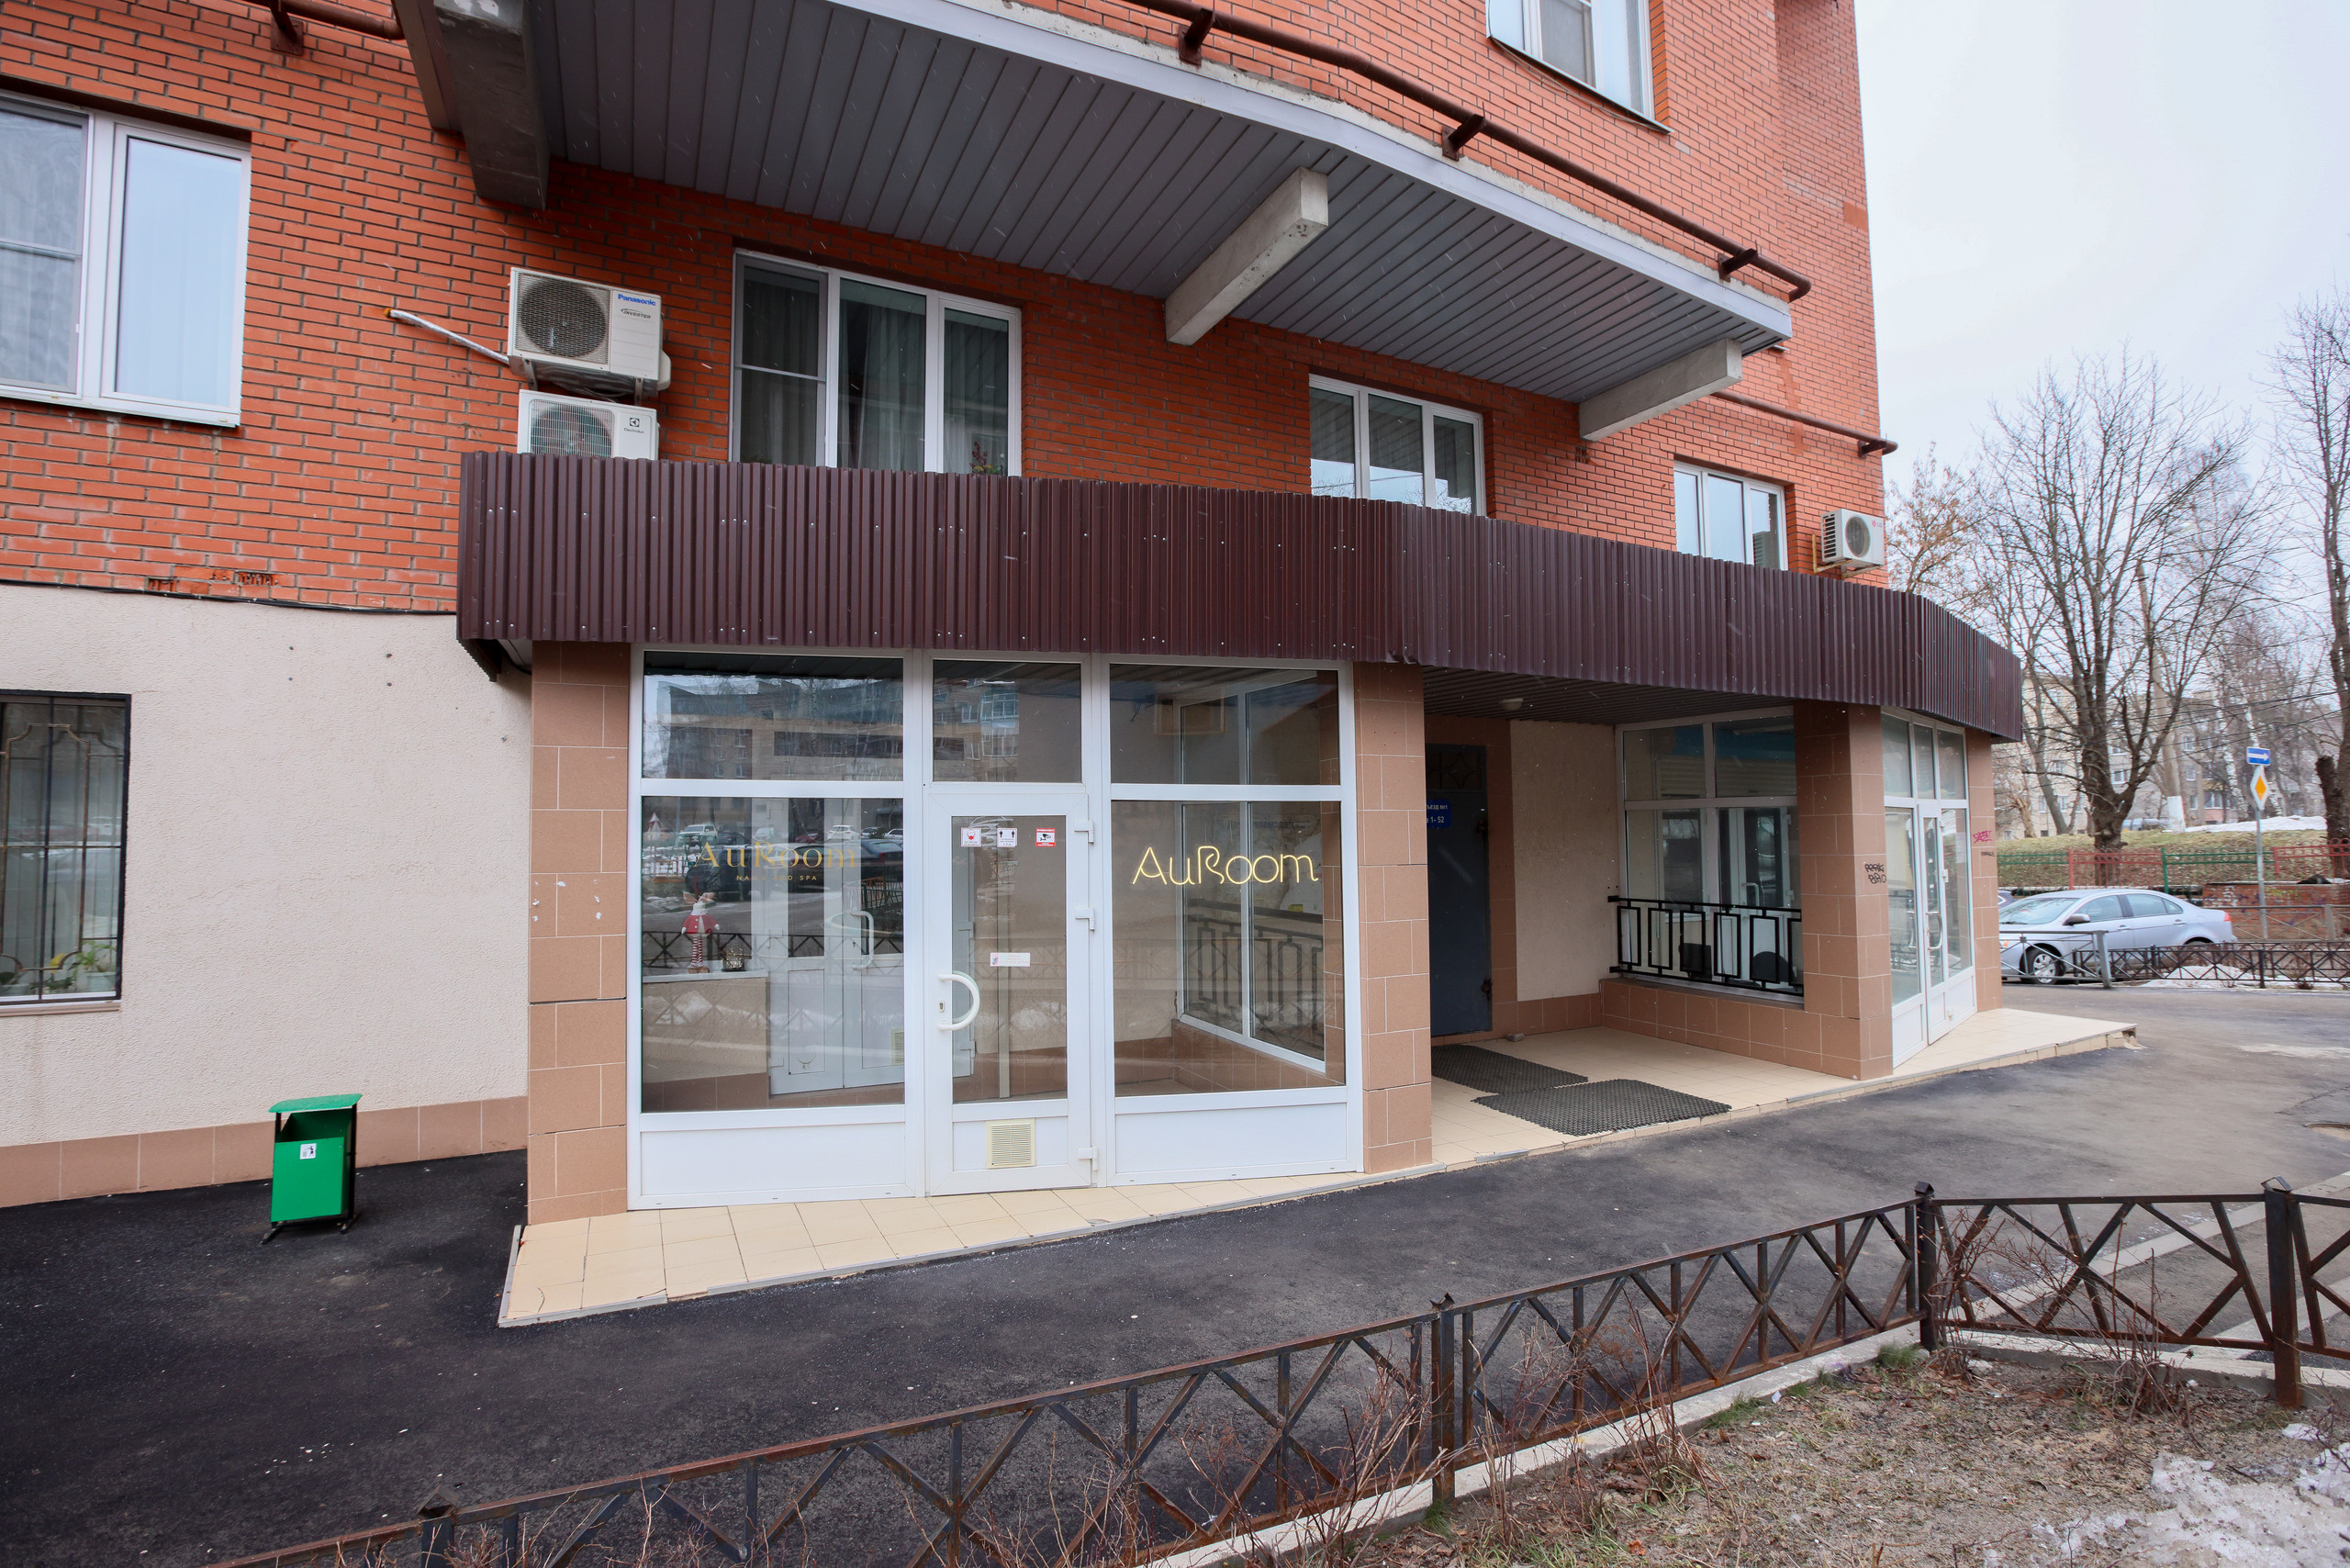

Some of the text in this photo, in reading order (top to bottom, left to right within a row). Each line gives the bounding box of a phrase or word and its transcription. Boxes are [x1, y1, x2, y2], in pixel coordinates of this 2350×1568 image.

[618, 294, 656, 306] Panasonic
[623, 310, 651, 319] INVERTER
[693, 841, 856, 868] AuRoom
[1132, 846, 1319, 885] AuRoom
